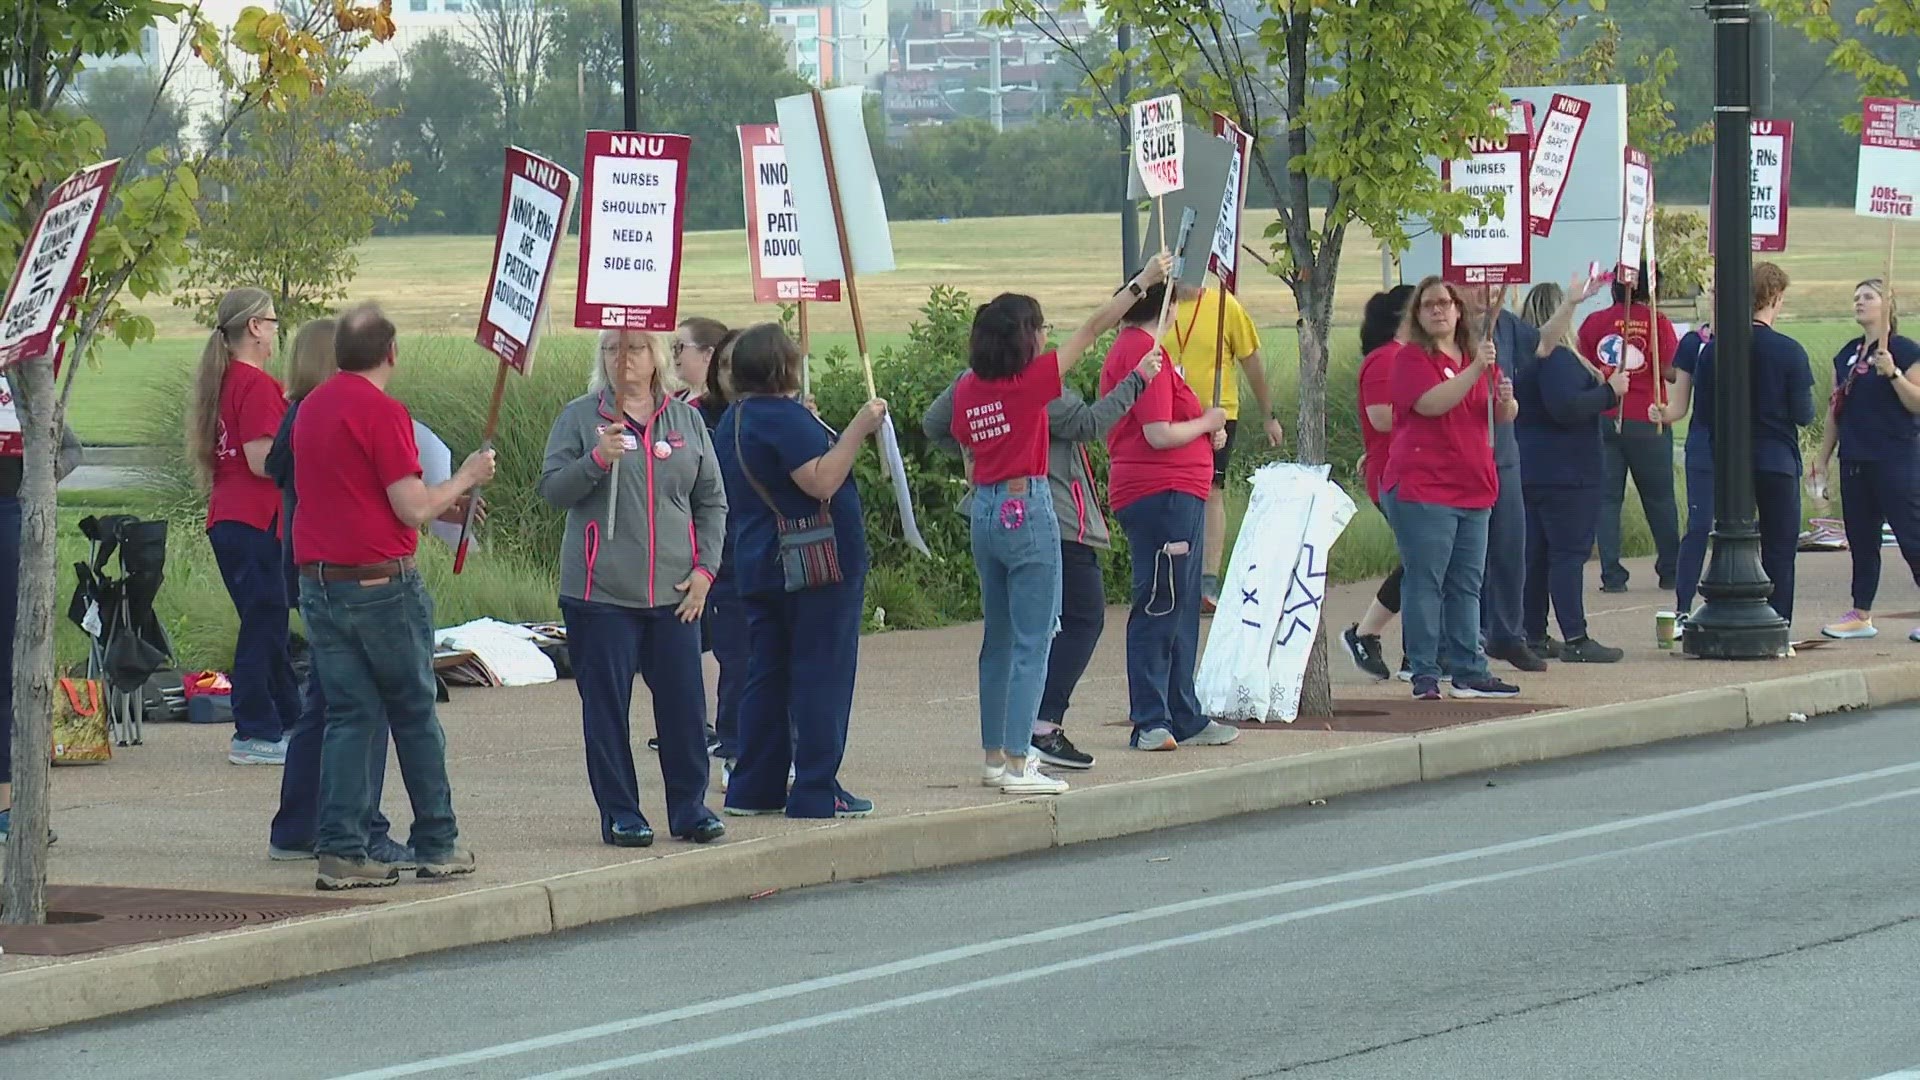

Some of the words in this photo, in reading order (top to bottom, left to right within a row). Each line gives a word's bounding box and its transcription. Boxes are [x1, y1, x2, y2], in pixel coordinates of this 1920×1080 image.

[1558, 98, 1581, 116] NNU
[610, 135, 665, 156] NNU
[1143, 133, 1176, 163] SLUH
[1756, 149, 1778, 166] RNs
[524, 157, 561, 190] NNU
[1466, 163, 1506, 175] NURSES
[59, 171, 101, 202] NNU
[612, 172, 659, 187] NURSES
[1465, 184, 1514, 196] HOULDN'T
[1870, 185, 1898, 200] JOBS
[602, 199, 667, 215] SHOULDN'T
[1751, 204, 1776, 220] ATES
[1869, 200, 1912, 216] JUSTICE
[510, 195, 536, 230] NNOC
[535, 208, 554, 243] RNs
[612, 229, 643, 243] NEED
[645, 230, 653, 243] A
[1464, 229, 1487, 239] SIDE
[1489, 229, 1510, 239] GIG.
[518, 232, 536, 259] ARE
[502, 252, 540, 293] PATIENT
[603, 256, 631, 271] SIDE
[634, 258, 656, 272] GIG.
[494, 279, 535, 323] ADVOCATES
[966, 401, 1003, 418] PROUD
[969, 412, 1005, 431] UNION
[971, 423, 1011, 442] NURSE
